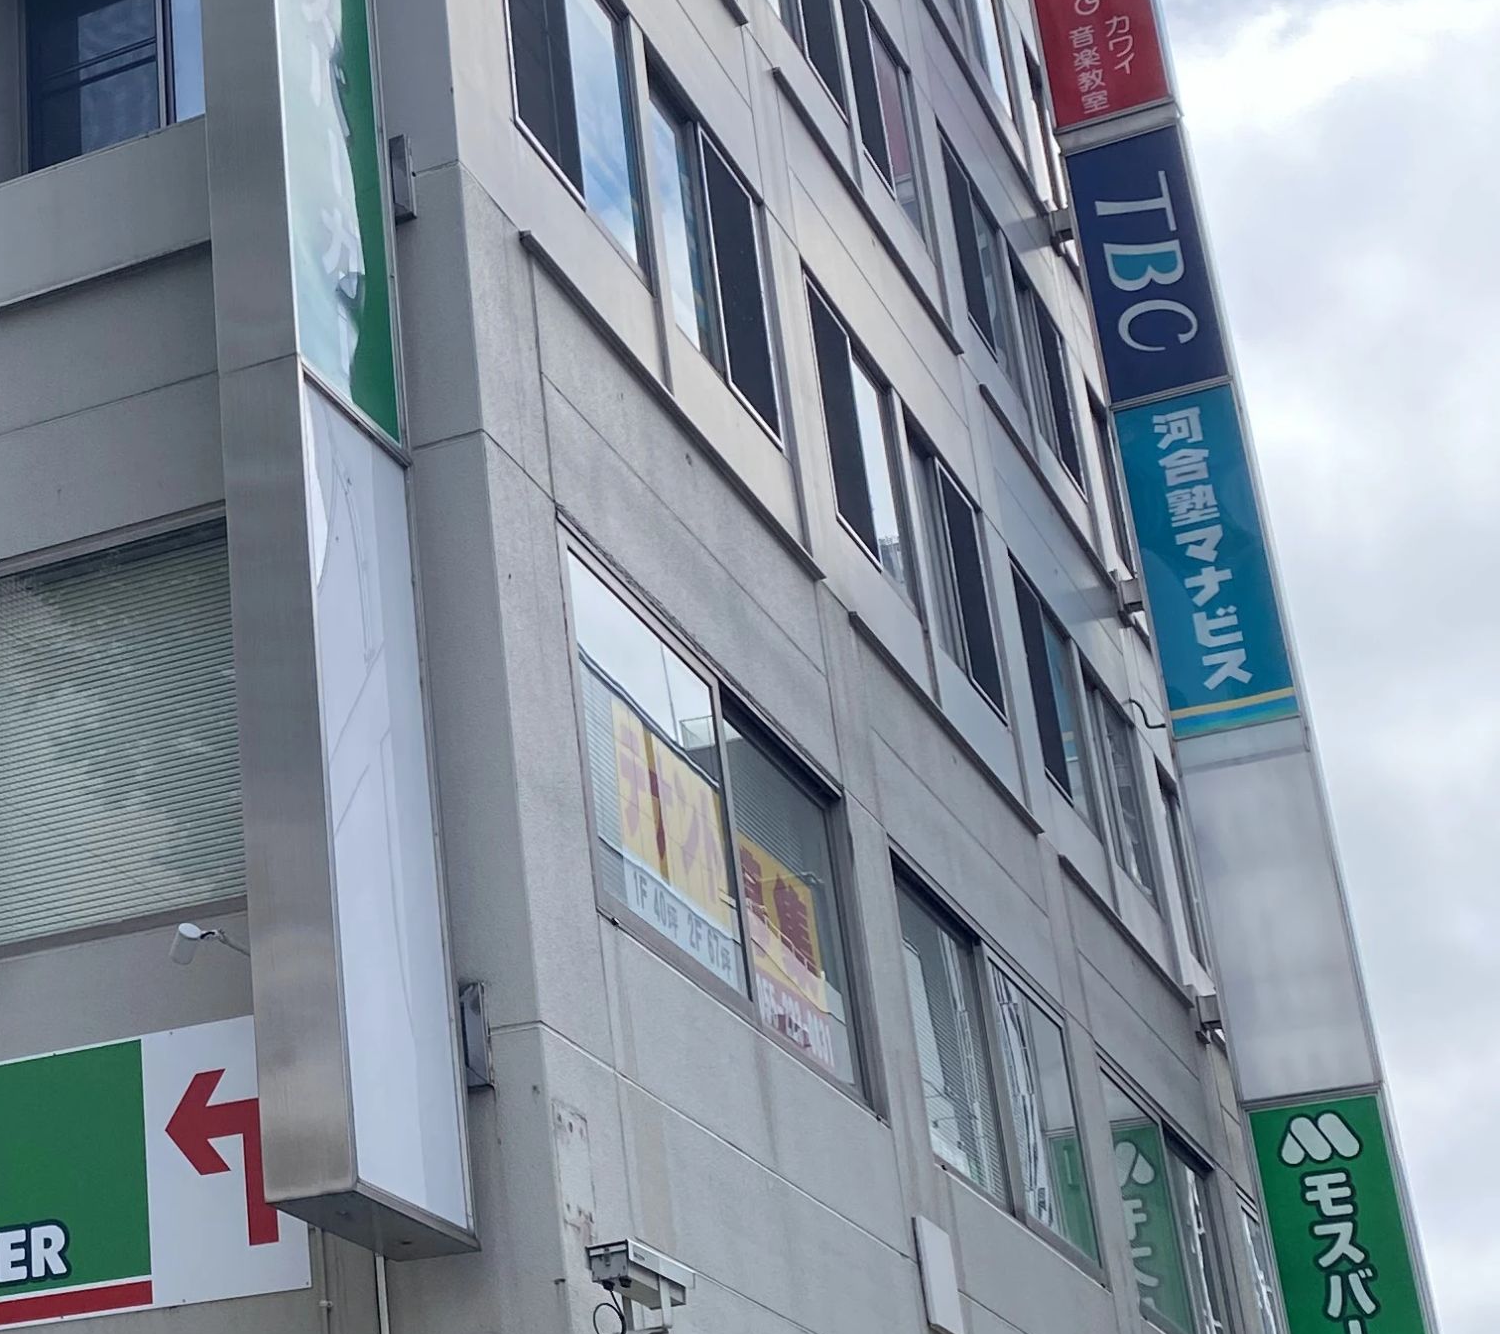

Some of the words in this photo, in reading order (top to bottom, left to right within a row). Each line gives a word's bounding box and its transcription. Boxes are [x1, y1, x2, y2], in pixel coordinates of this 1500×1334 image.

[1068, 24, 1110, 115] 音楽教室
[1105, 15, 1135, 75] カワイ
[1094, 170, 1198, 353] TBC
[1152, 405, 1254, 692] 河合塾マナビス
